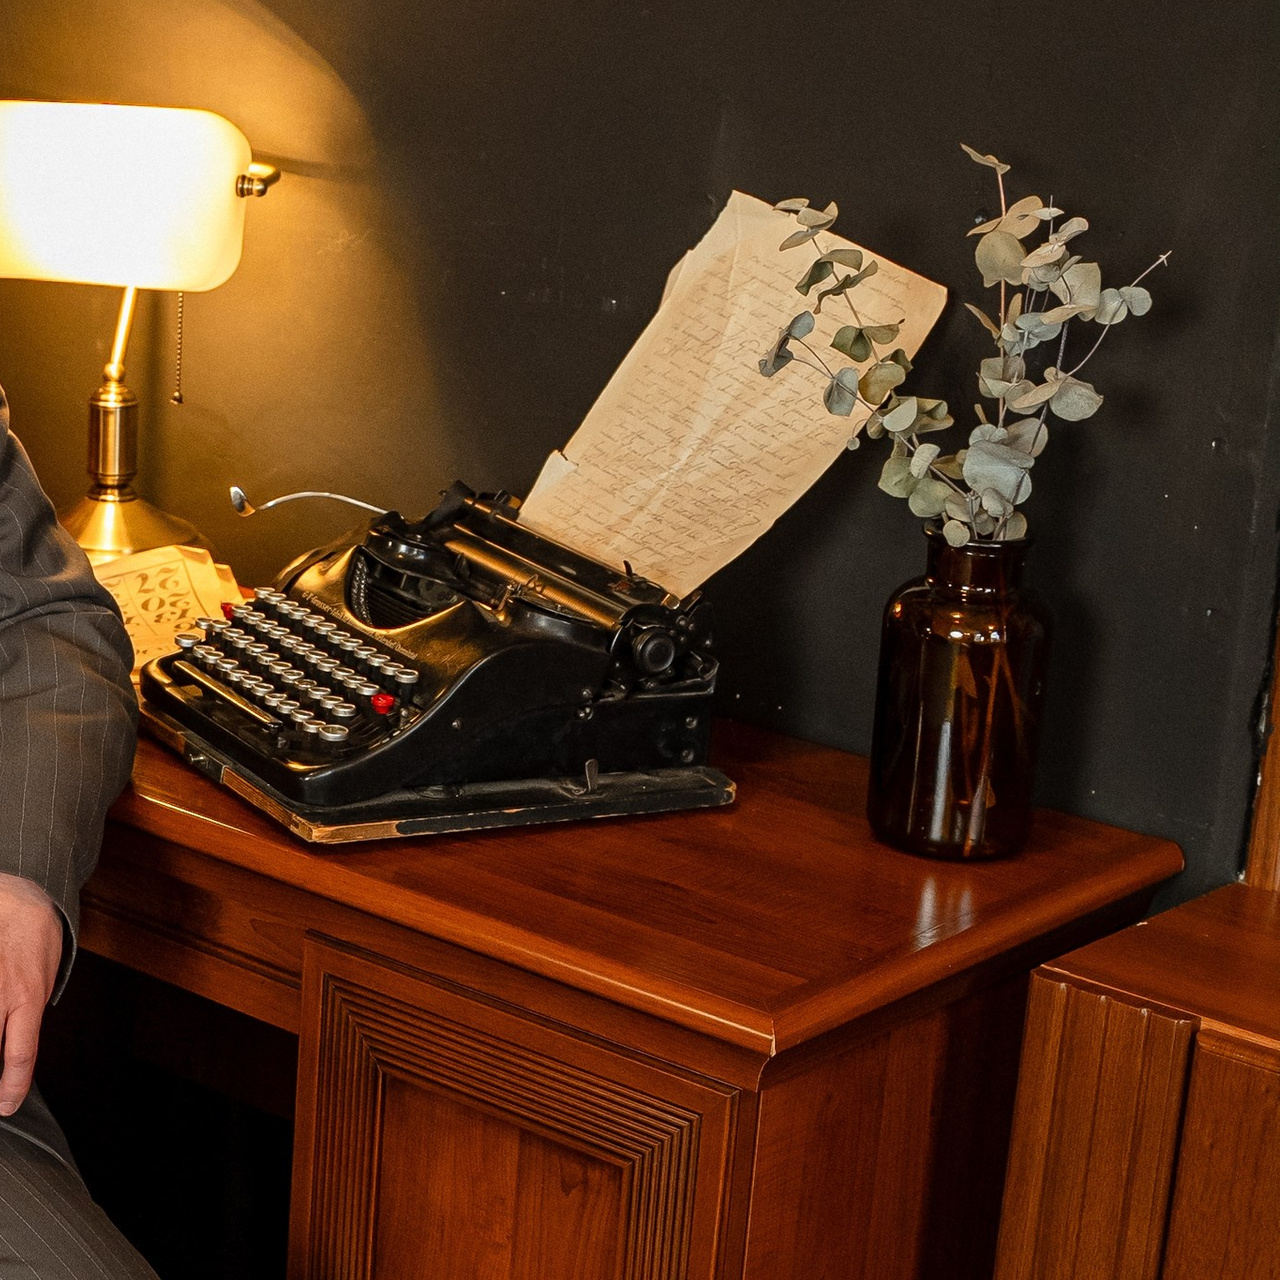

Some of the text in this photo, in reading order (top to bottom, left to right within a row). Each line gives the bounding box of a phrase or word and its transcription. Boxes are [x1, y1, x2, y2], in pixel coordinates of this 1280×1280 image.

[136, 566, 180, 594] 27
[141, 591, 191, 612] 20
[153, 607, 190, 624] 13
